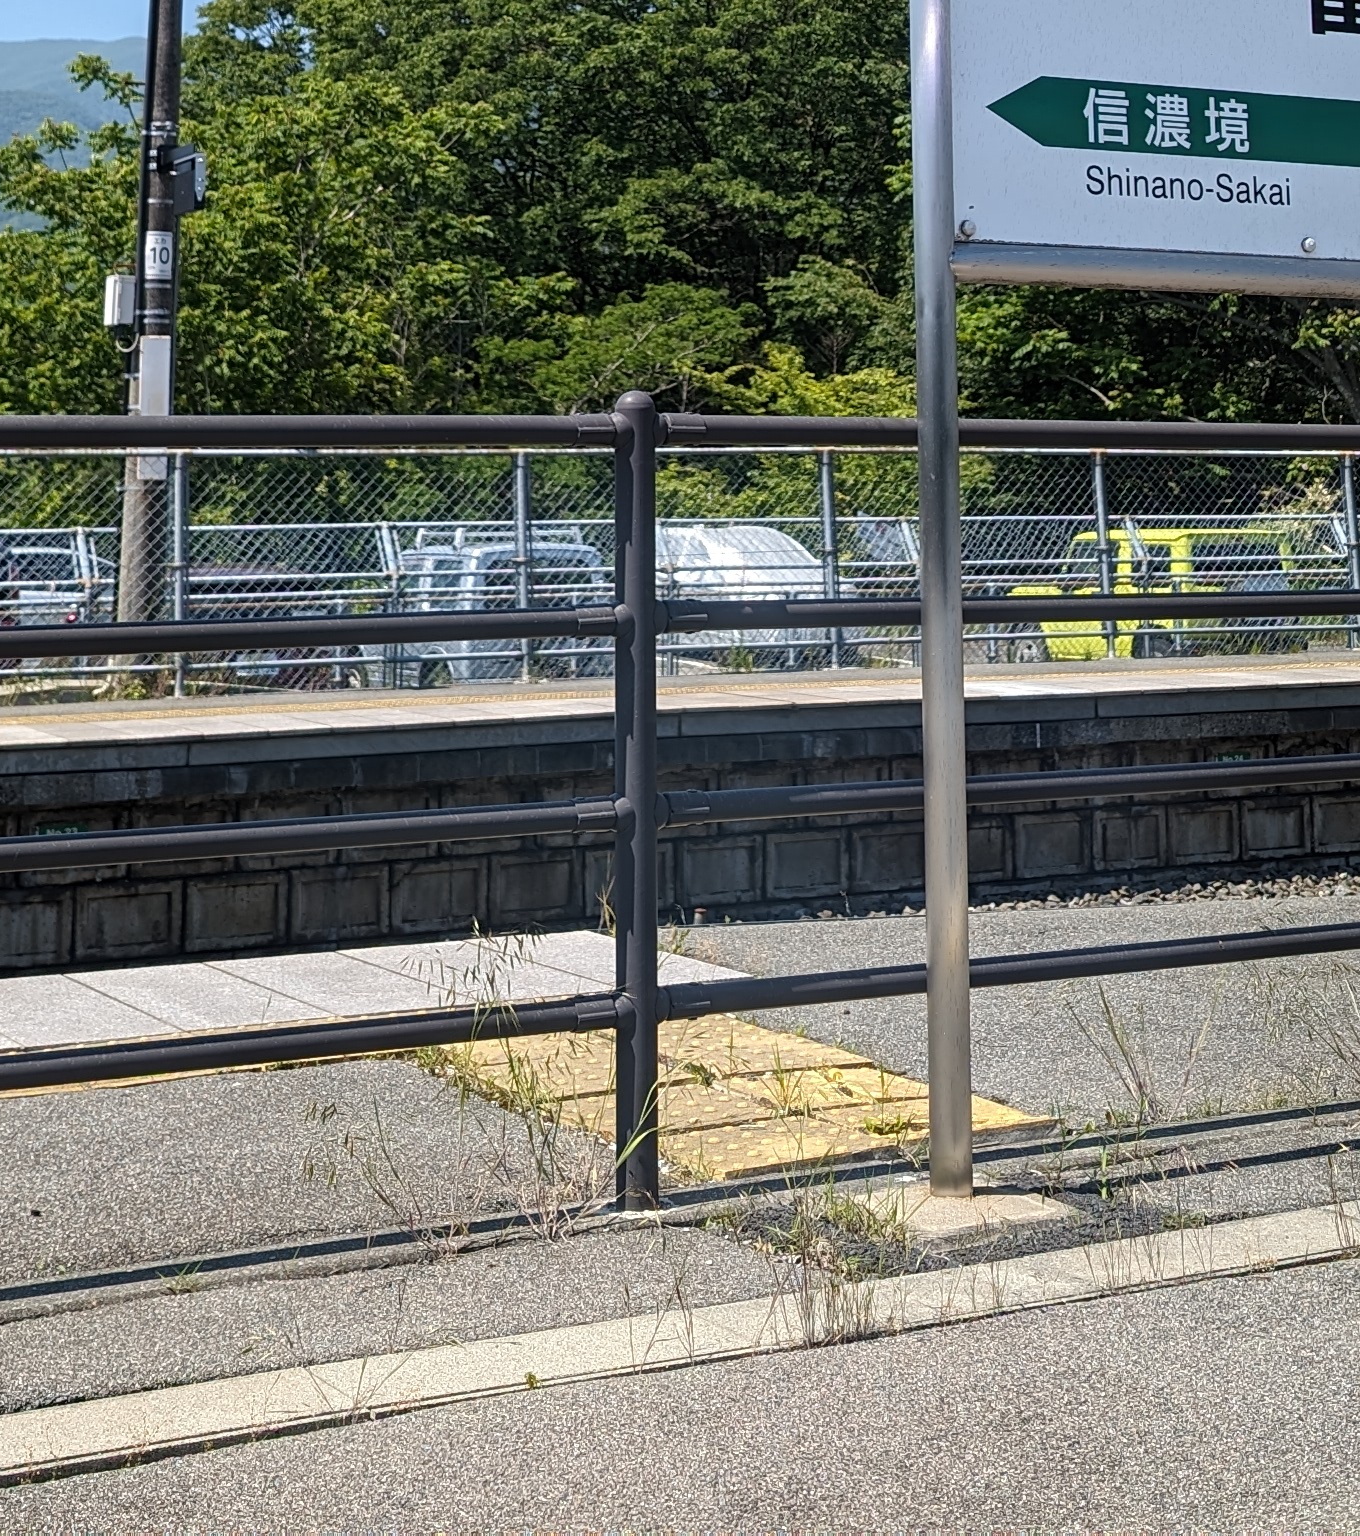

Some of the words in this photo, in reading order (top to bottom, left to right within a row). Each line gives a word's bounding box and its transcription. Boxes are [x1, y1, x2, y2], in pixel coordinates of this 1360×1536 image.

[1083, 87, 1250, 153] 信濃境
[1085, 165, 1291, 206] Shinano-Sakai
[150, 246, 170, 265] 10
